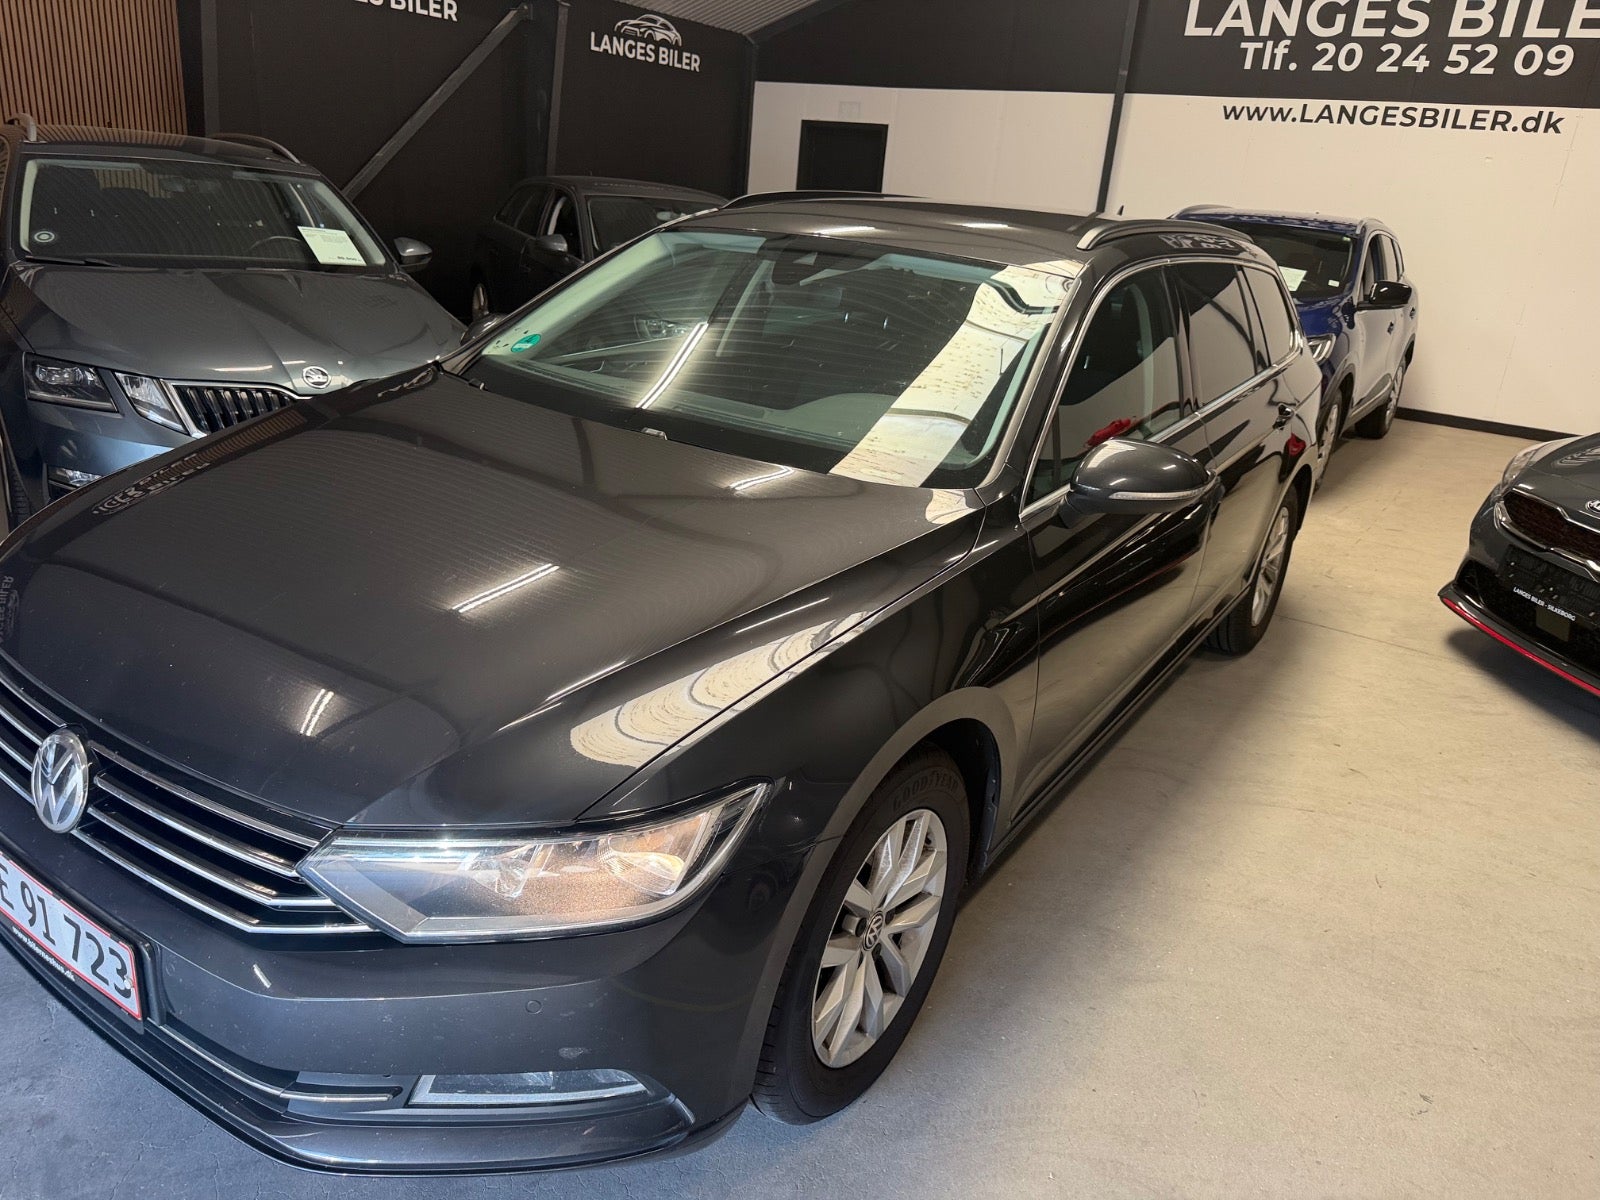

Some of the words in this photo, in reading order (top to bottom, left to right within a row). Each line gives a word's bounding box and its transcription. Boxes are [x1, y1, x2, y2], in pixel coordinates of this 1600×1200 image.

[1184, 0, 1430, 38] LANGES
[590, 31, 656, 63] LANGES
[658, 46, 701, 72] BILER
[1240, 39, 1298, 71] Tlf.
[1311, 42, 1364, 72] 20
[1375, 43, 1430, 73] 24
[1443, 43, 1499, 75] 52
[1513, 44, 1575, 77] 09
[1222, 103, 1565, 134] www.LANGESBILER.dk
[1513, 586, 1532, 600] LANGES
[20, 880, 56, 946] 91
[63, 913, 132, 999] 723
